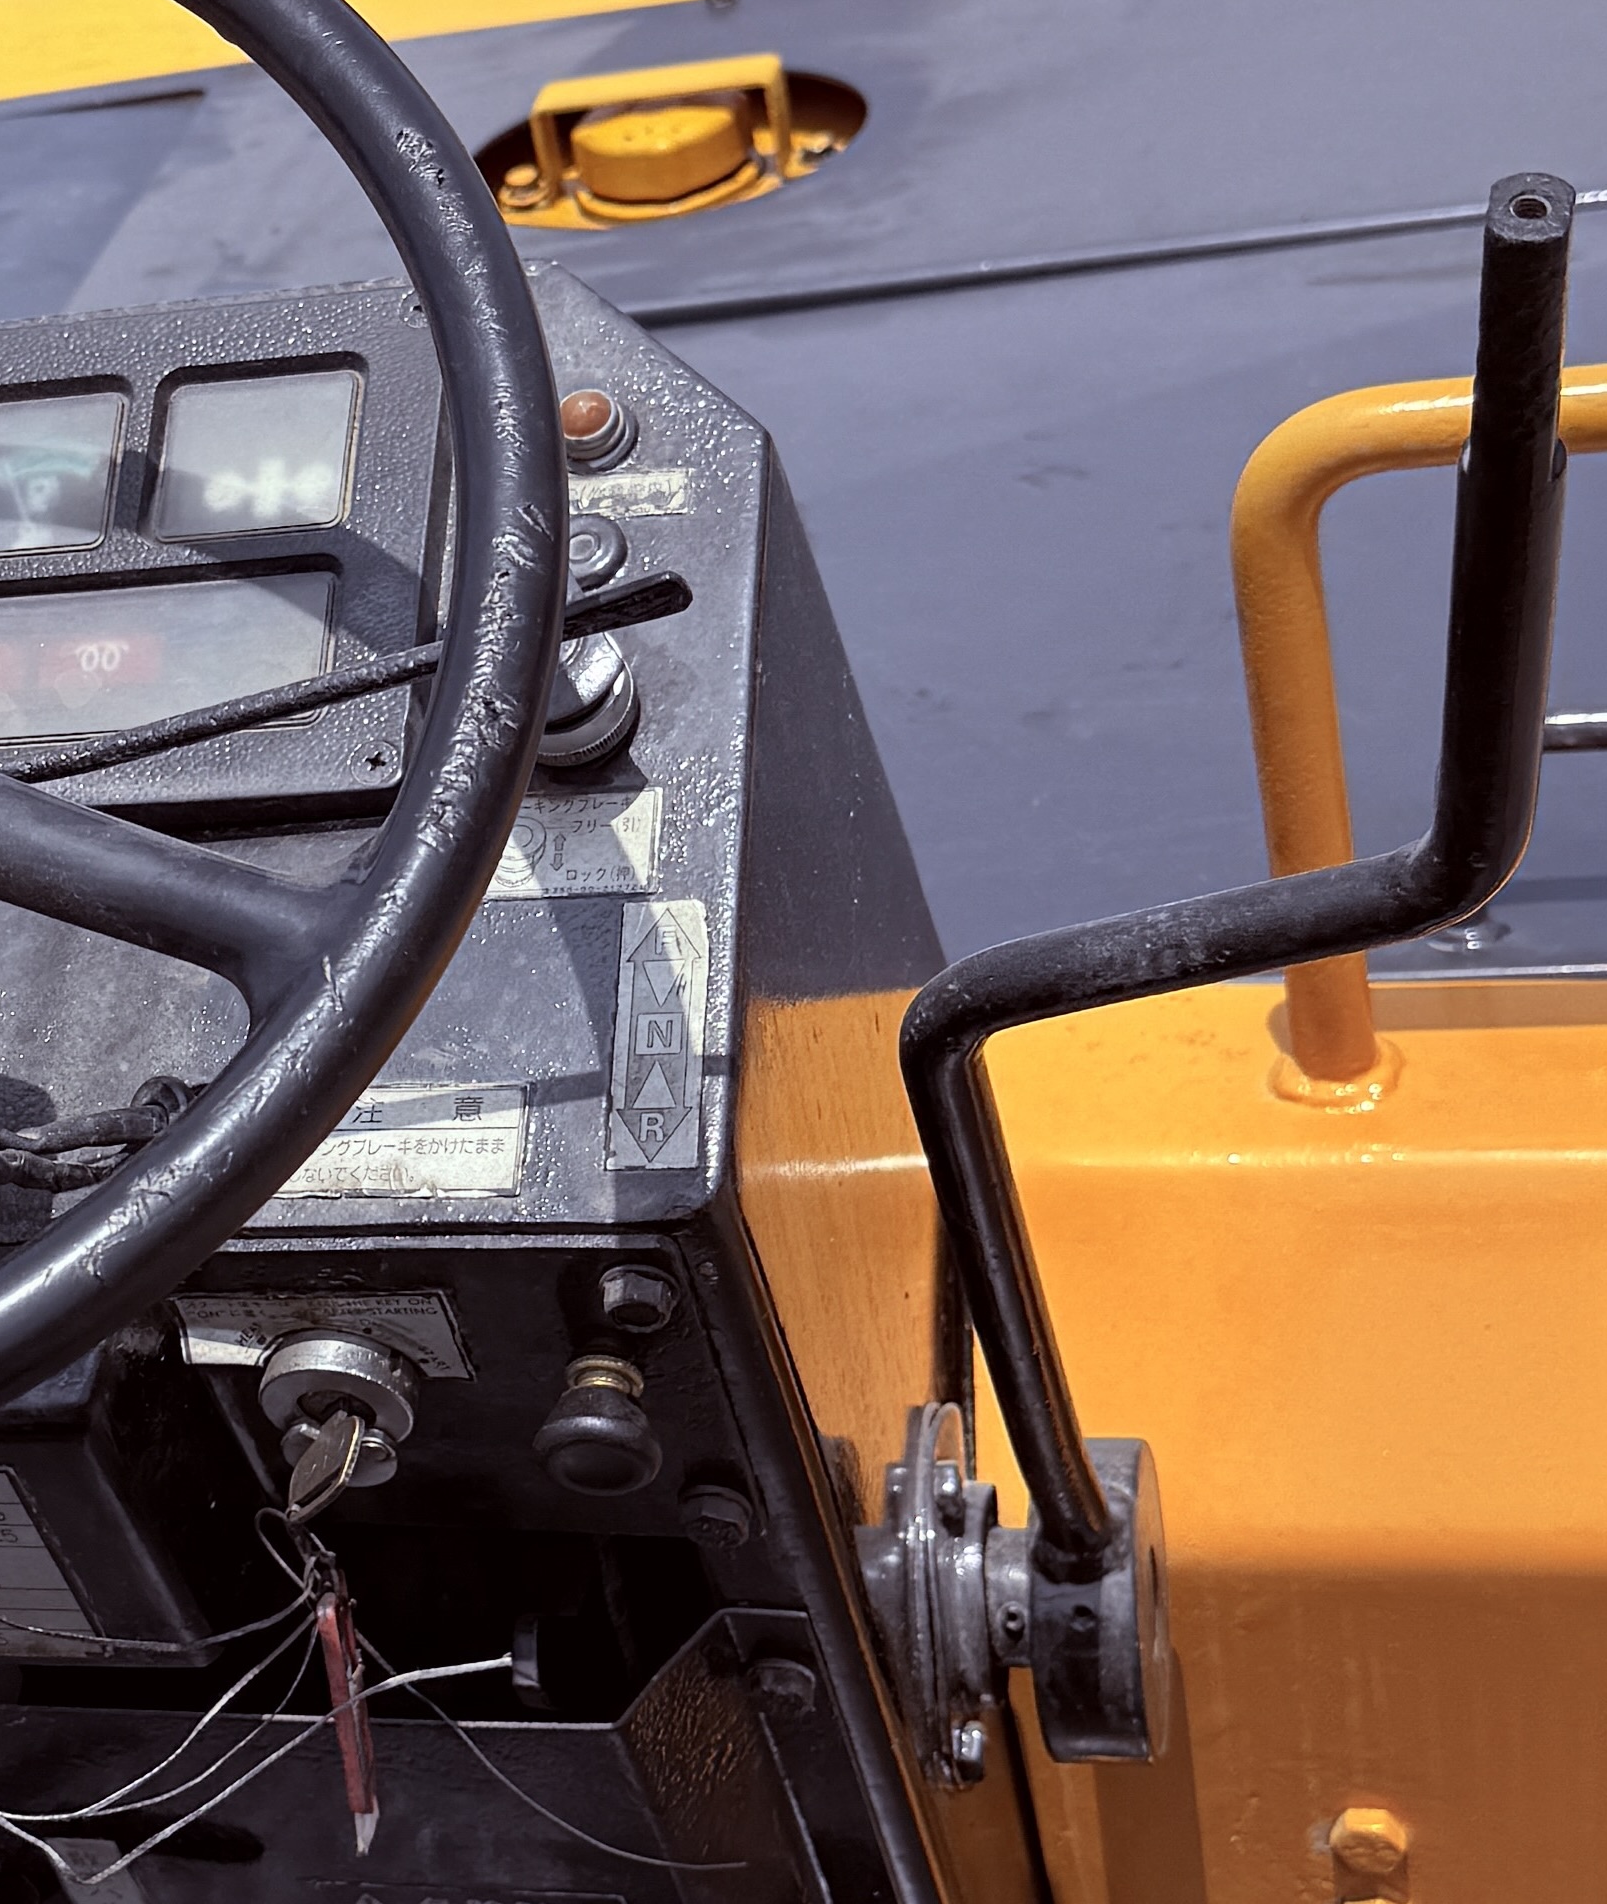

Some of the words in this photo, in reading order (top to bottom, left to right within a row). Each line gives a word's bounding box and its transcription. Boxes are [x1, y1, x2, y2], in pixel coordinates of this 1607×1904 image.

[655, 925, 677, 955] F
[646, 1019, 674, 1048] N
[638, 1112, 665, 1143] R
[321, 1137, 505, 1157] ングブレーキをかけたまま
[407, 1297, 432, 1306] ON
